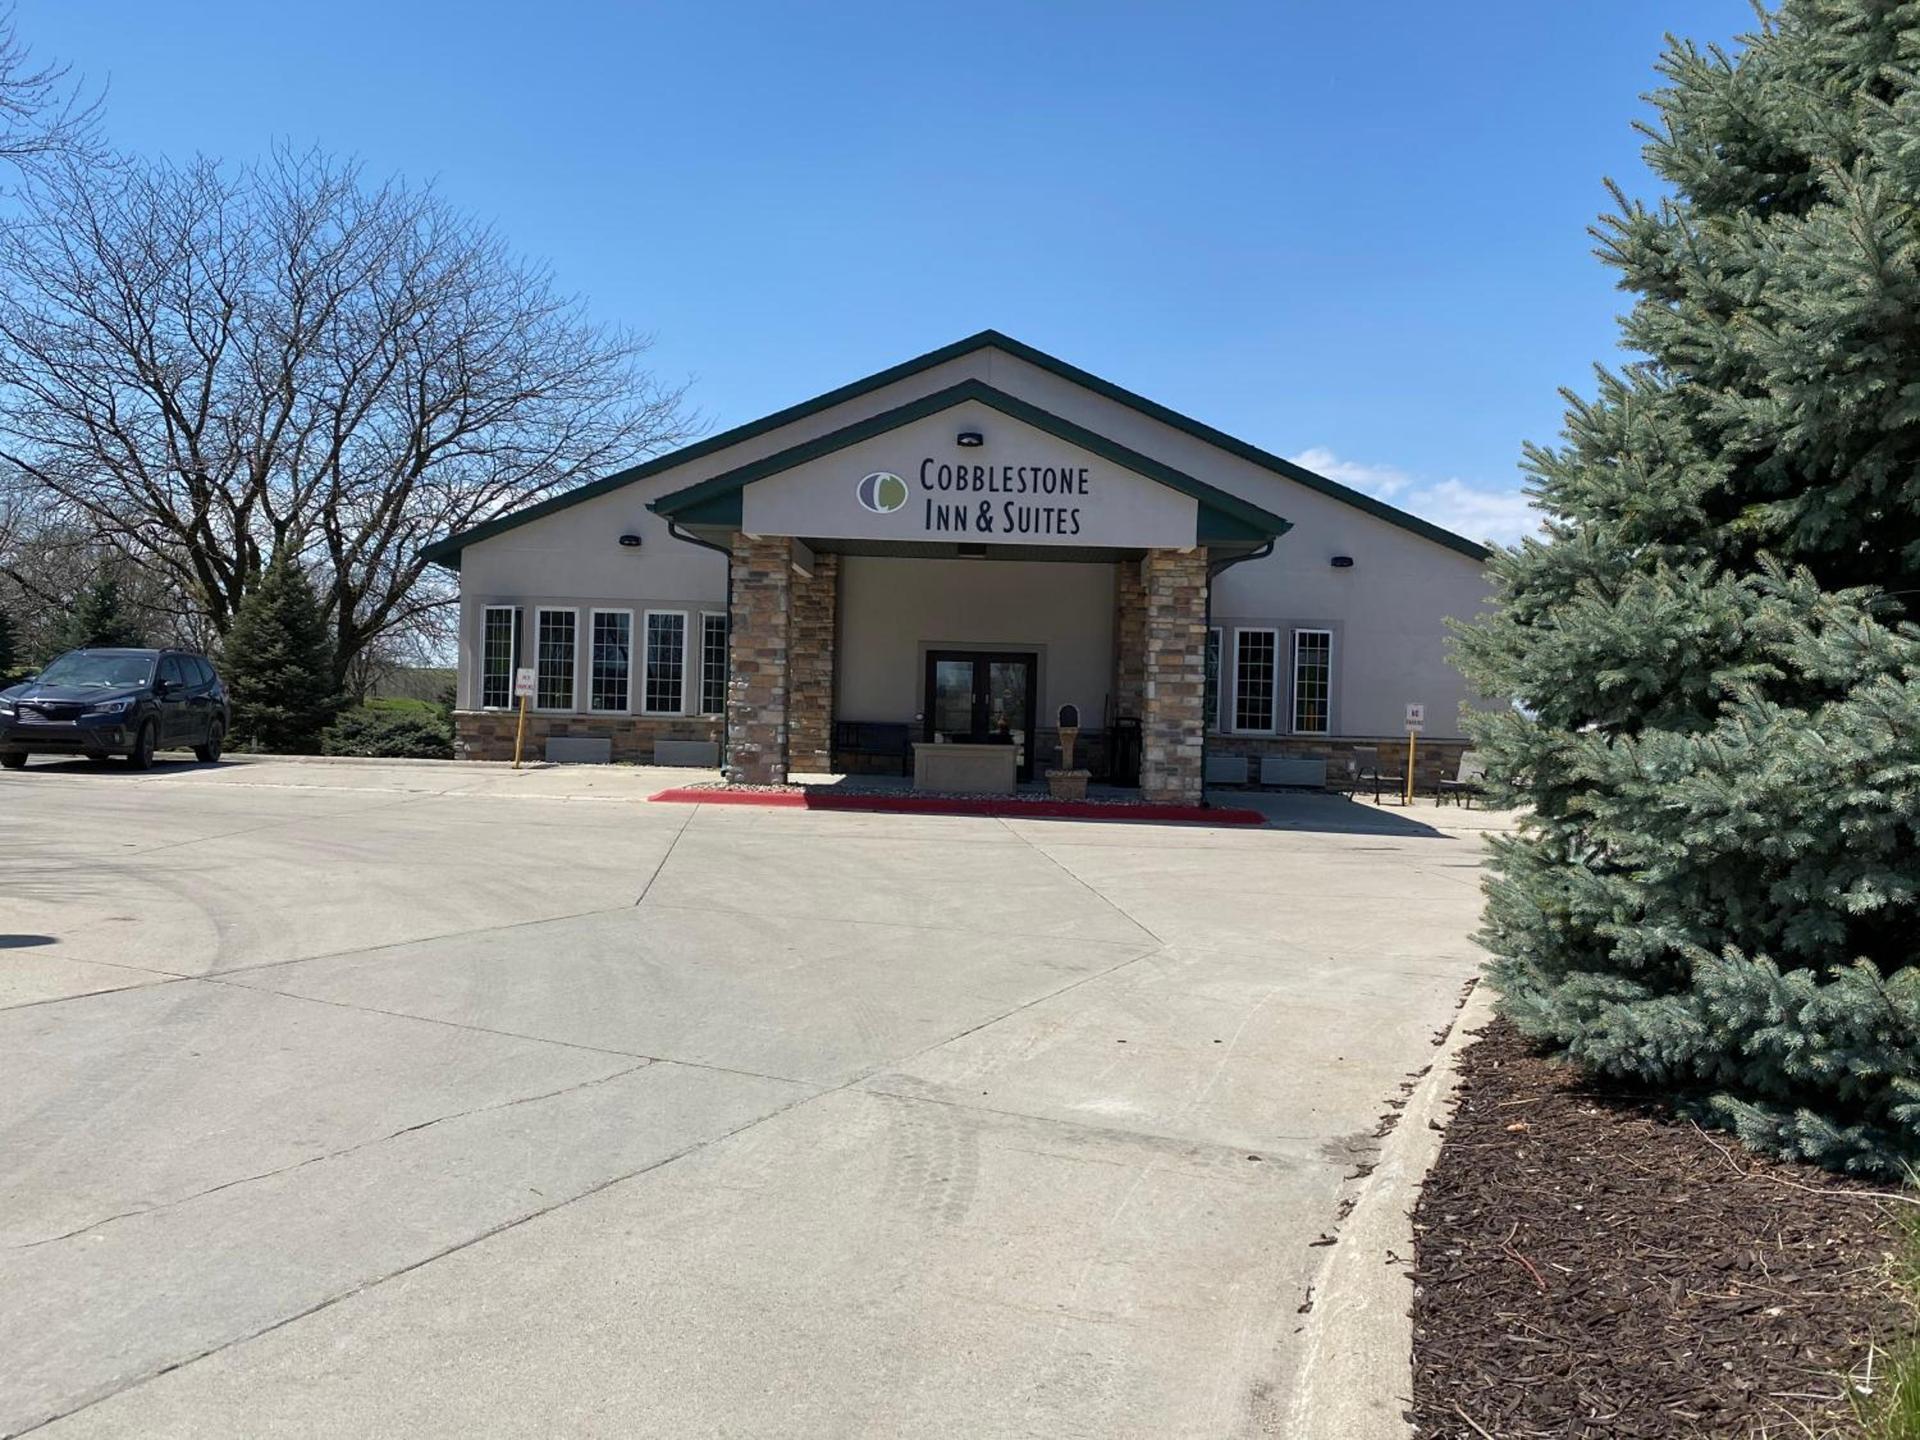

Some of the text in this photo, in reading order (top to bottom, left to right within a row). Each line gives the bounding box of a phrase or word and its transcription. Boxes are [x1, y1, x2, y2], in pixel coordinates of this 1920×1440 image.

[920, 458, 1089, 495] COBBLESTONE
[925, 498, 1081, 535] INN & SUITES
